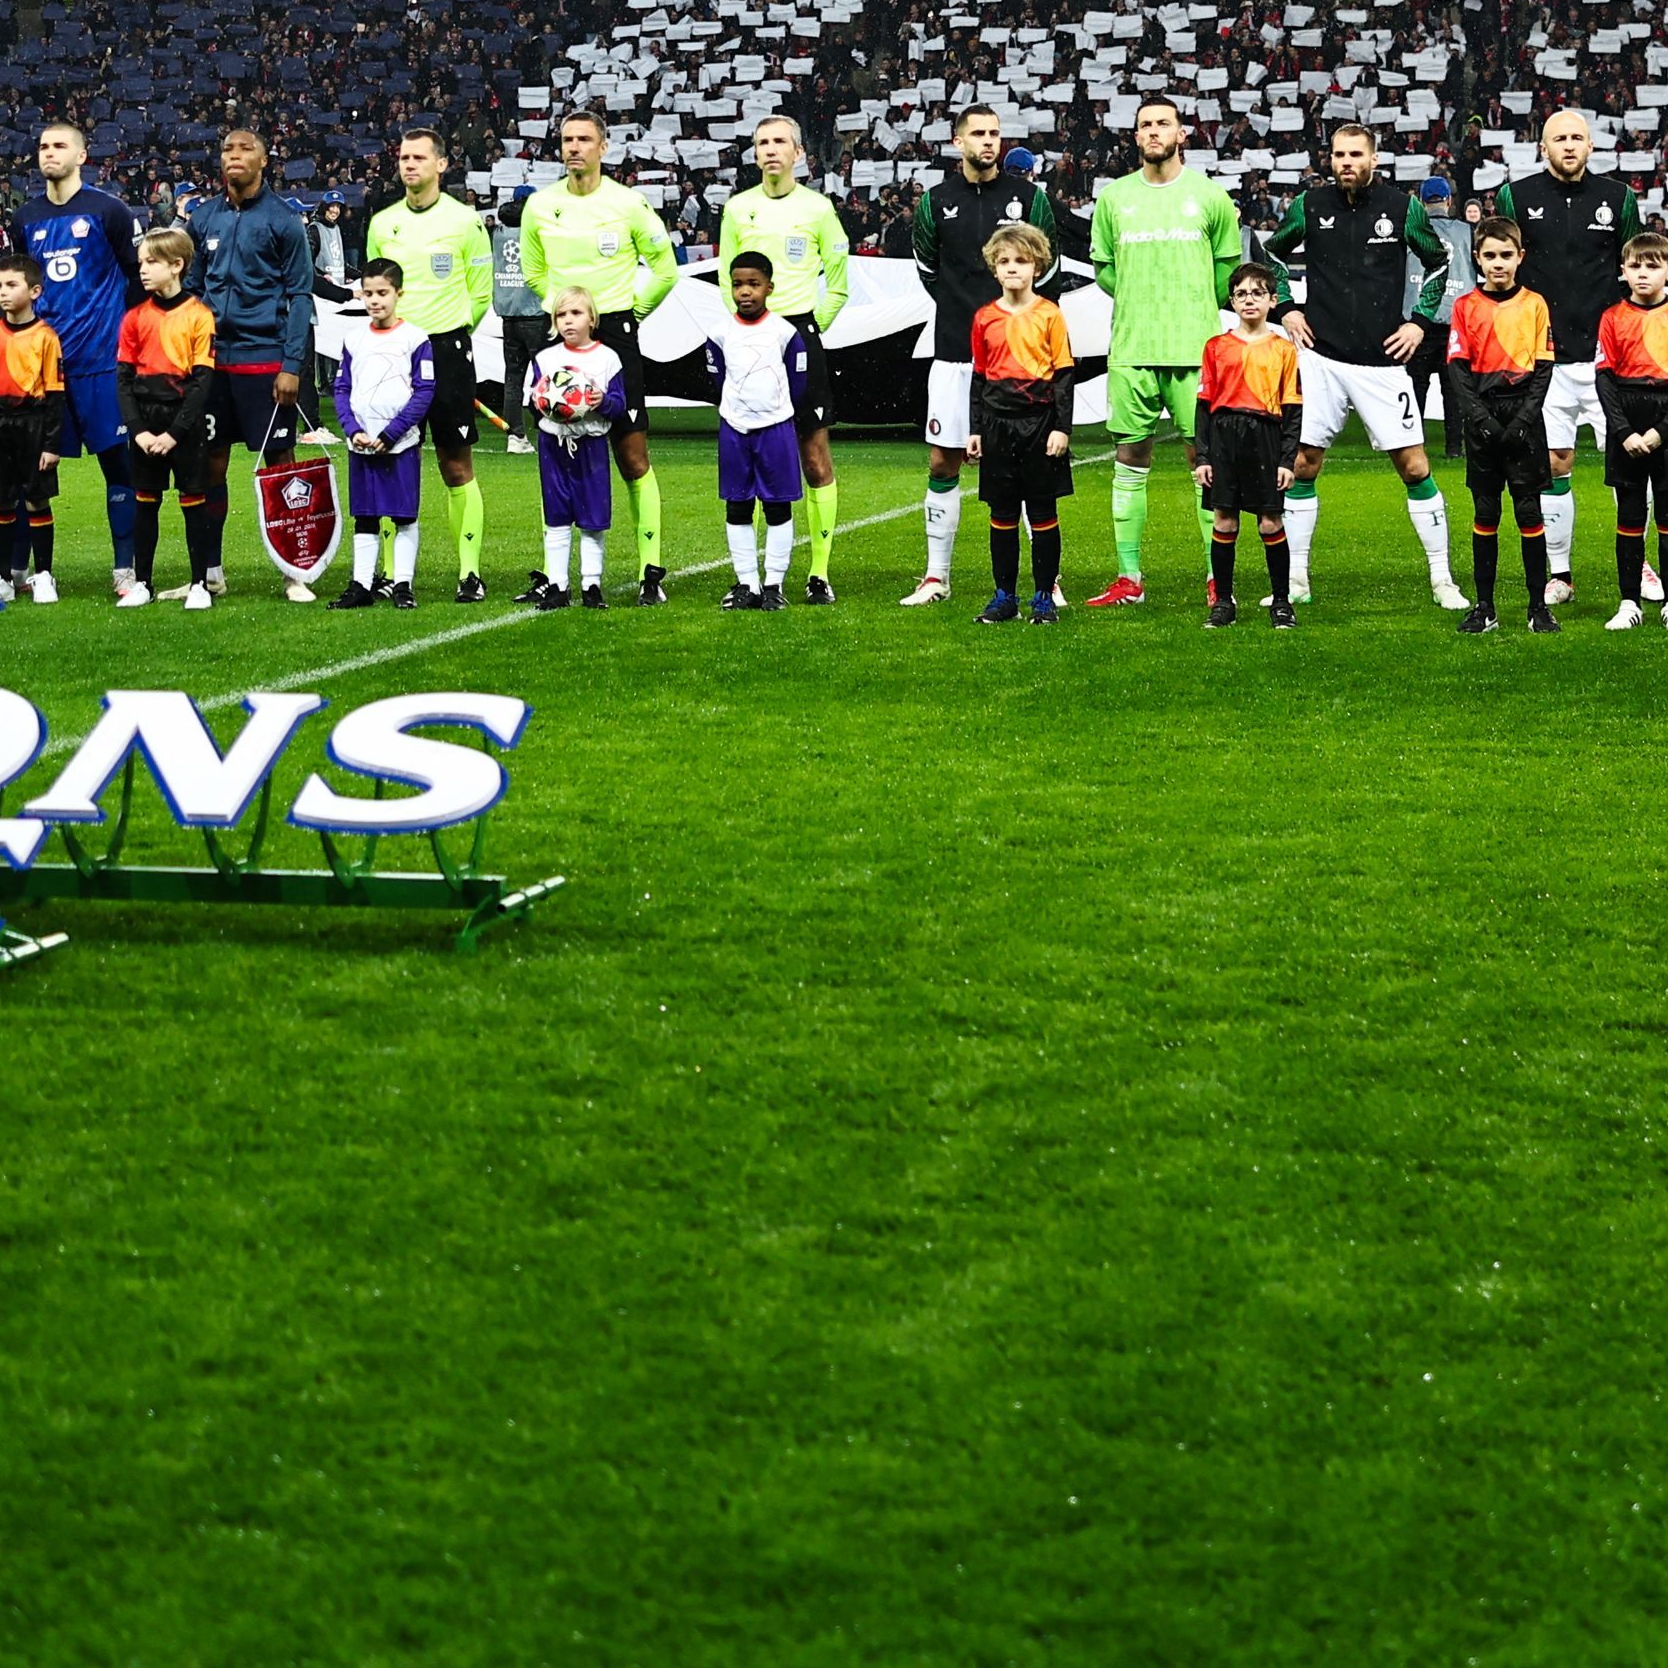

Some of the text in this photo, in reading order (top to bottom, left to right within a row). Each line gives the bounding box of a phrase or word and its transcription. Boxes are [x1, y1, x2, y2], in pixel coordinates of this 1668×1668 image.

[494, 272, 524, 280] CHAMPIO
[1398, 391, 1413, 420] 2
[927, 505, 946, 524] F
[1430, 511, 1444, 527] F
